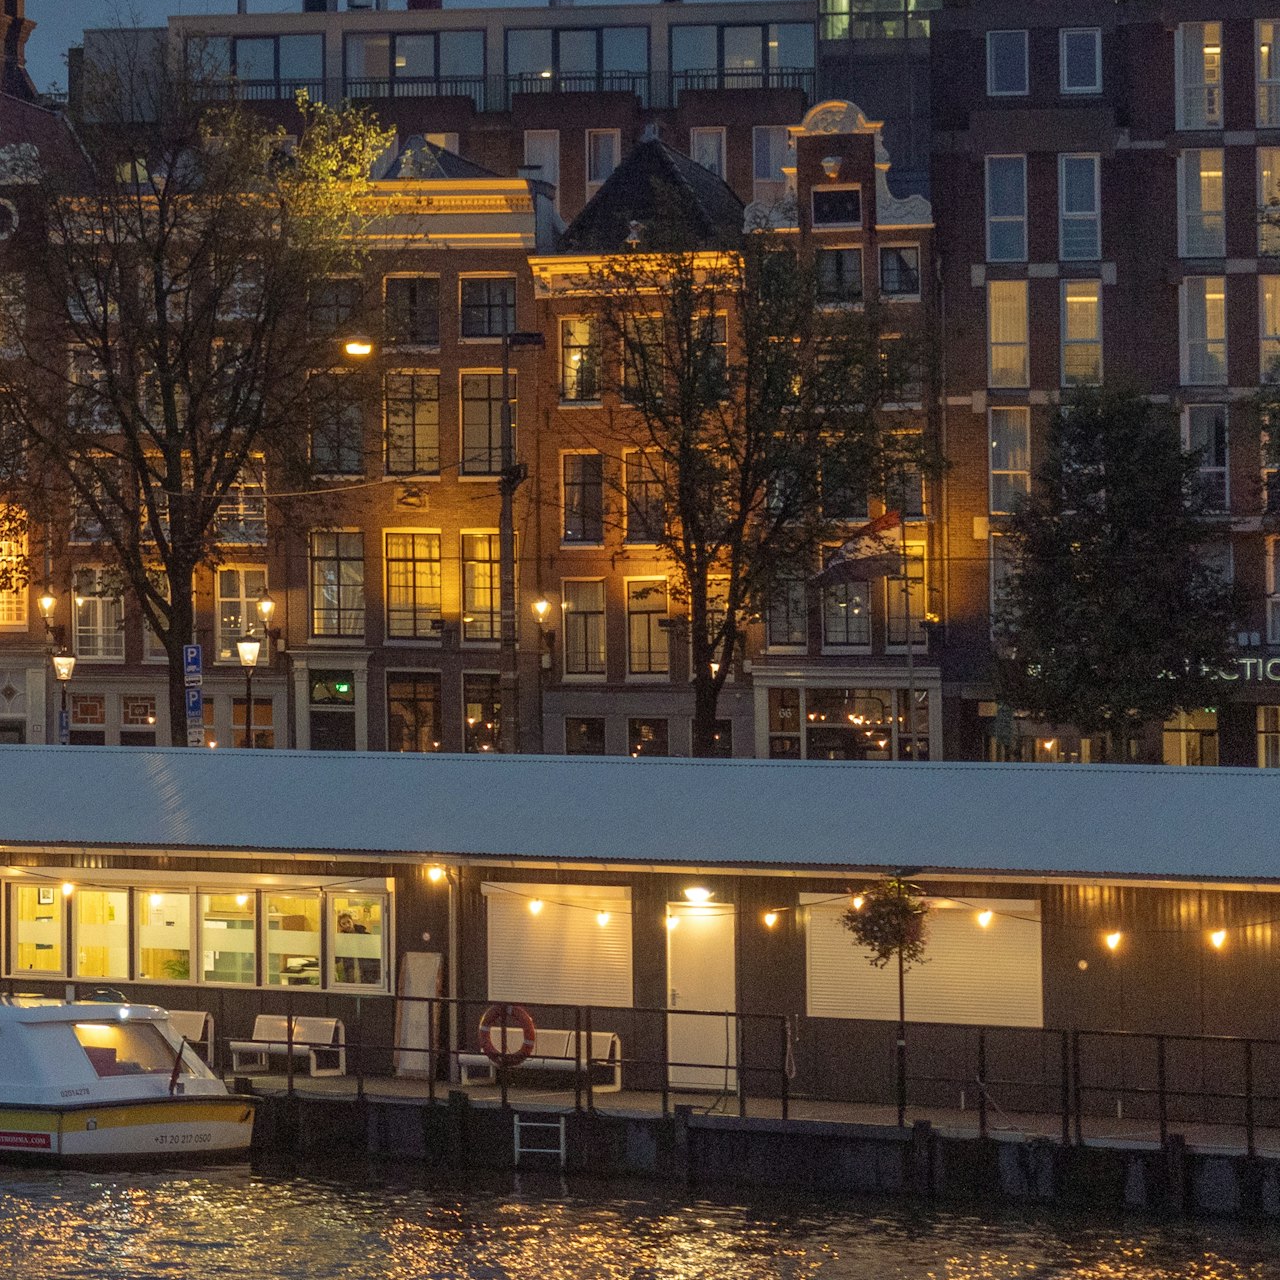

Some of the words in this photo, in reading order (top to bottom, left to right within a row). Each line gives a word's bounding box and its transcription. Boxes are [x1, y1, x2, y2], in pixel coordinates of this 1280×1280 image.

[187, 648, 197, 662] P
[188, 691, 198, 707] P
[154, 1135, 167, 1144] +31
[169, 1135, 180, 1144] 20
